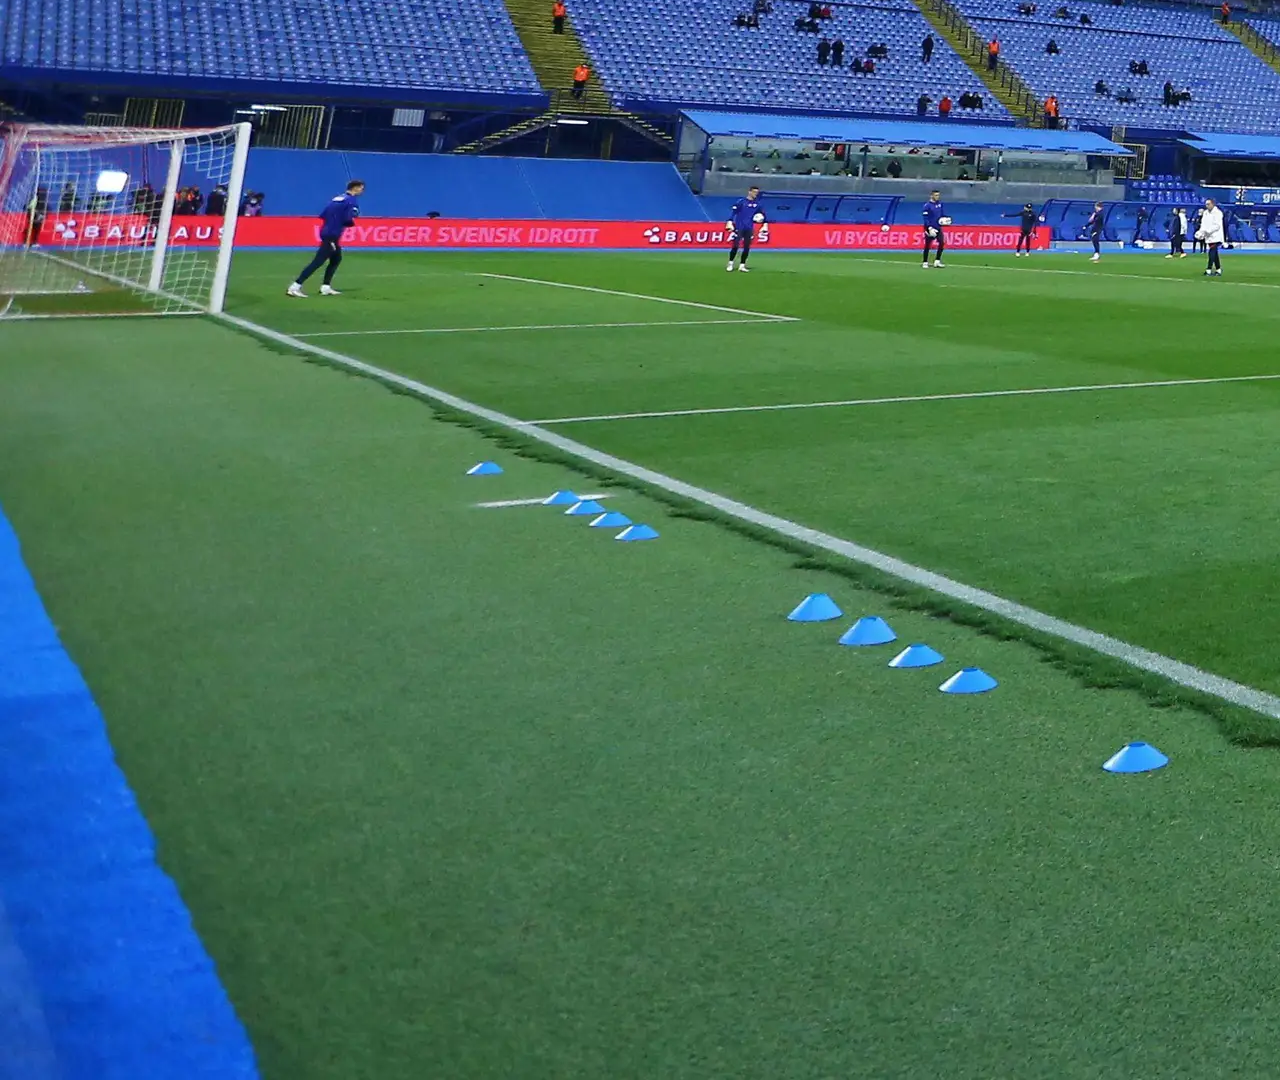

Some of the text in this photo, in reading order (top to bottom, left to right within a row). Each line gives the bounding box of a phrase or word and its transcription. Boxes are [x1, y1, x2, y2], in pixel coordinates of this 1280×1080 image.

[342, 225, 432, 243] BYGGER
[438, 226, 523, 244] SVENSK
[528, 227, 600, 244] IDROTT
[664, 230, 769, 243] BAUHAS
[824, 231, 841, 245] VI
[845, 231, 908, 246] BYGGER
[911, 231, 975, 246] SNSK
